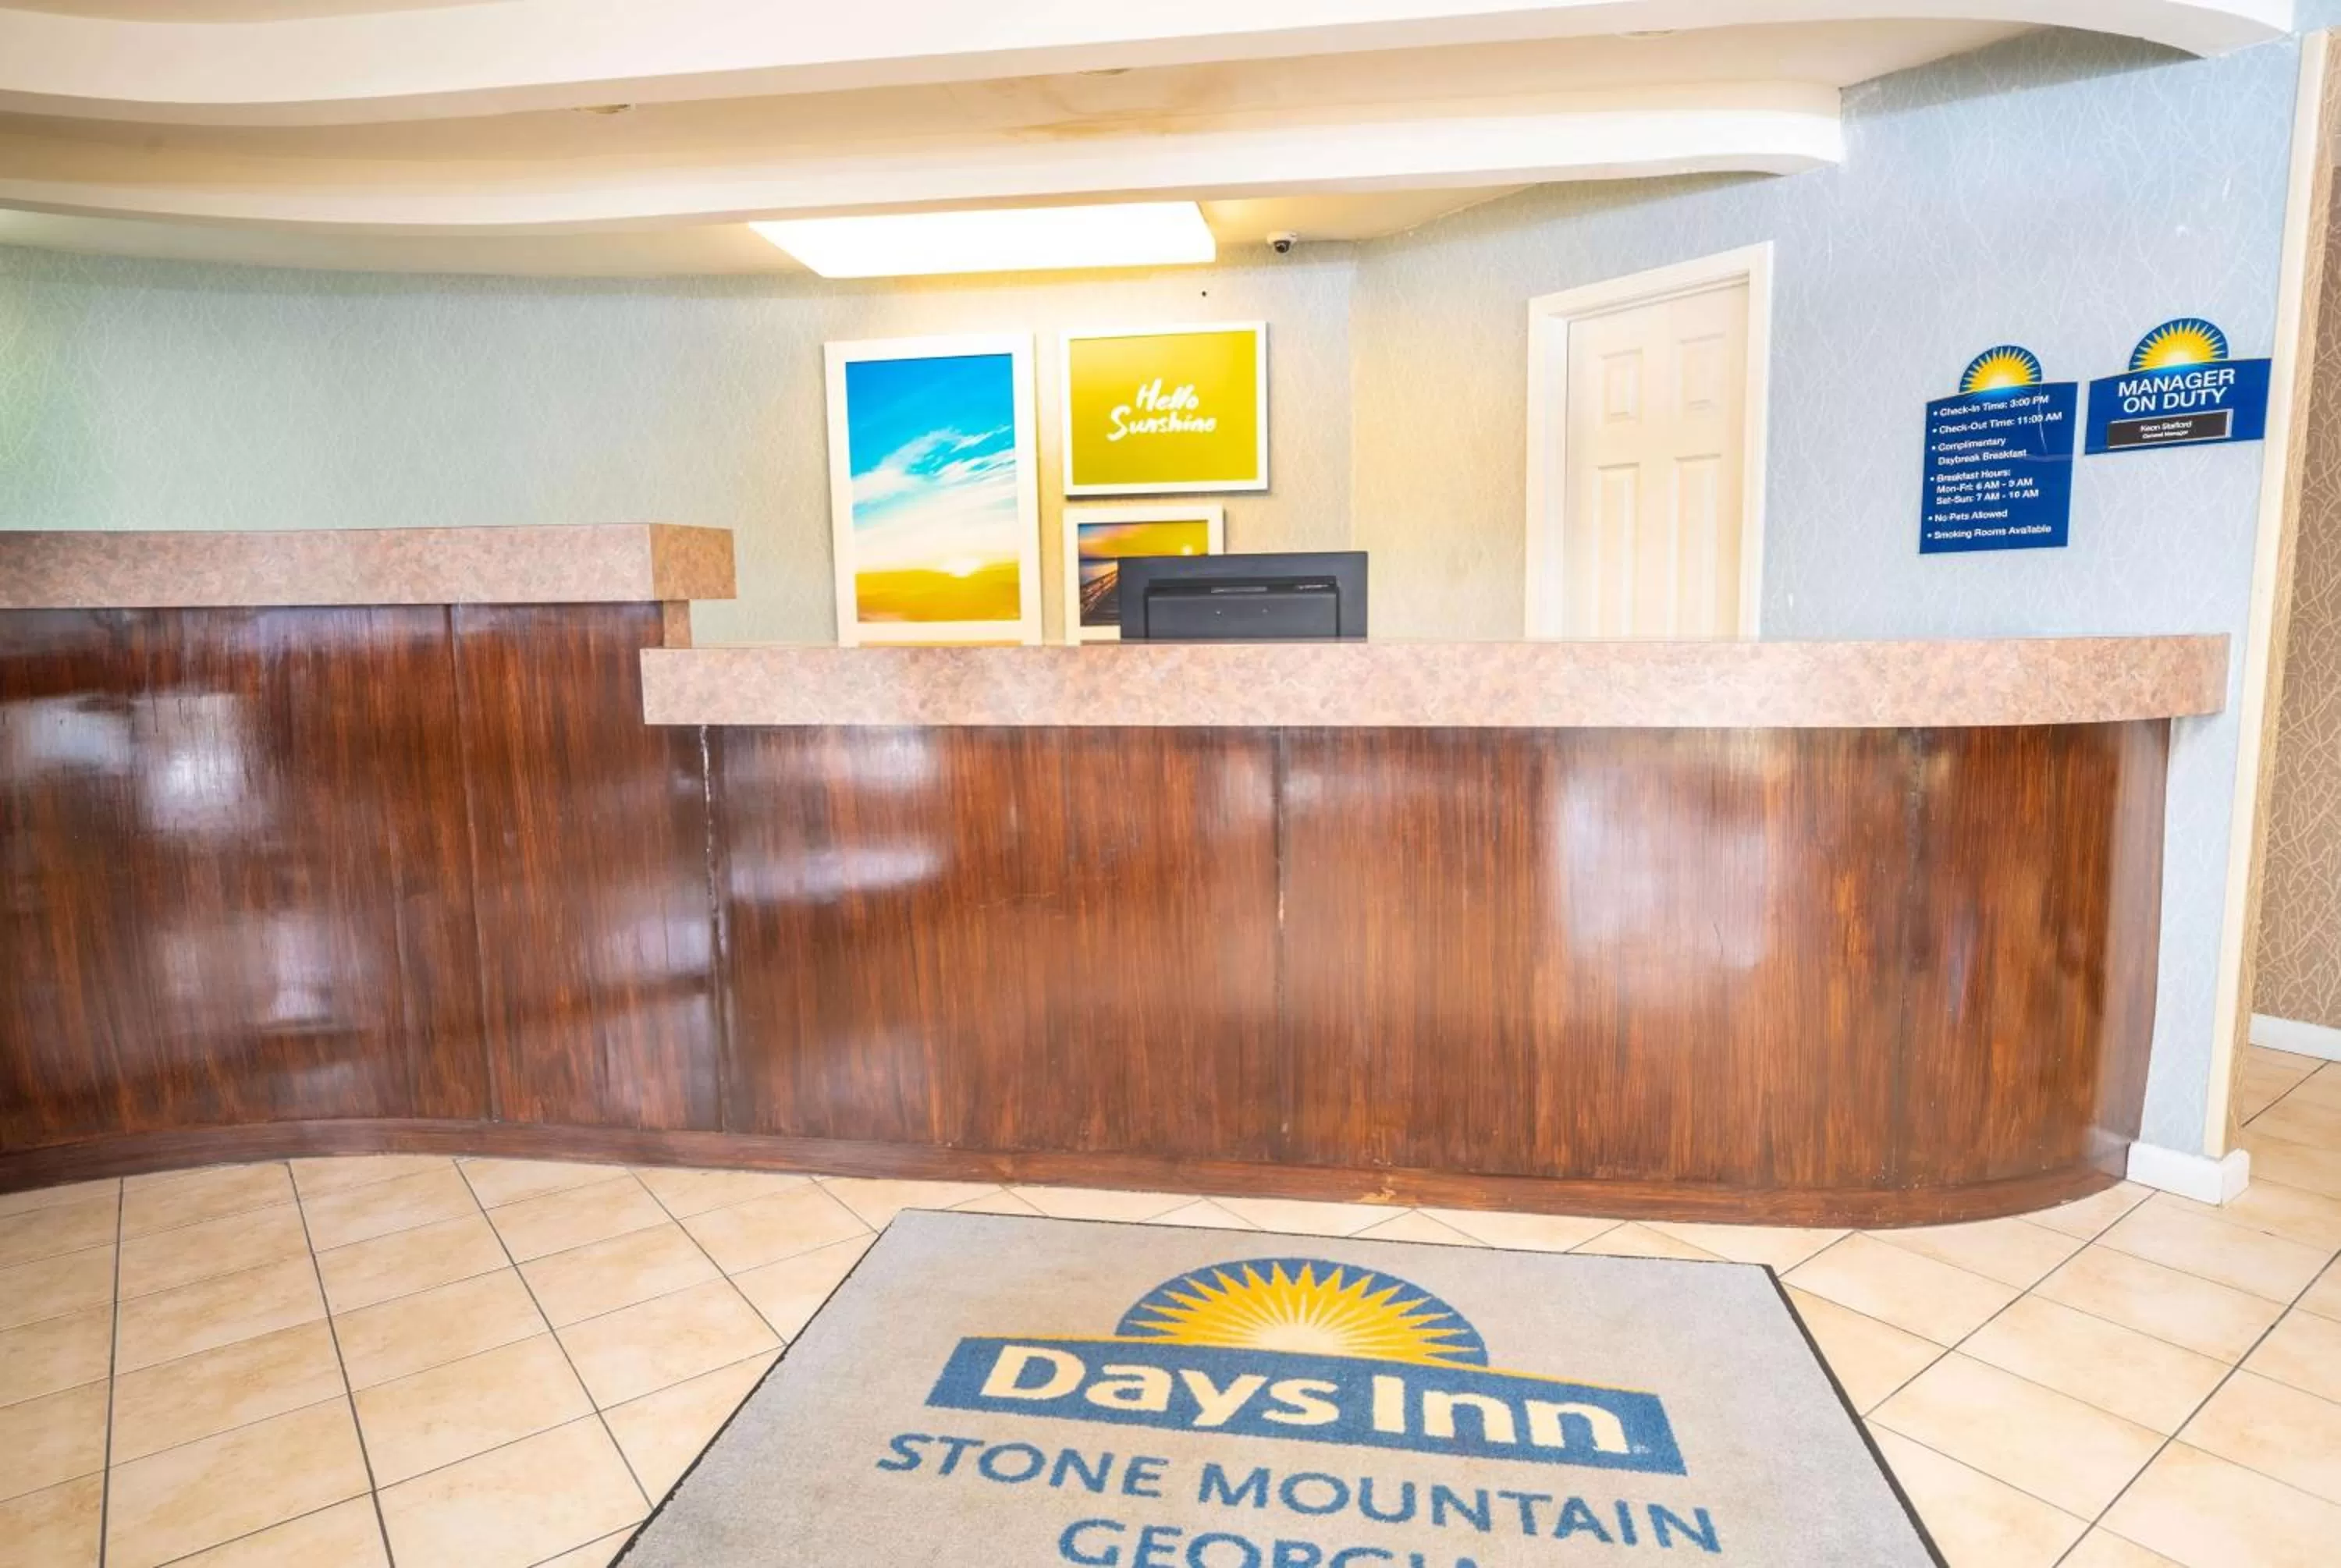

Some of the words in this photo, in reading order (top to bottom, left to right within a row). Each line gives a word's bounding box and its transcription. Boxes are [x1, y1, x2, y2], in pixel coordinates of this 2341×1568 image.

[2118, 368, 2235, 397] MANAGER
[1136, 378, 1199, 413] Hello
[1939, 405, 1980, 417] Check-In
[1984, 402, 2008, 411] Time:
[2010, 399, 2029, 408] 3:00
[2032, 395, 2050, 405] PM
[2123, 396, 2156, 413] ON
[2162, 387, 2227, 410] DUTY
[1107, 406, 1217, 442] Sunshine
[1939, 421, 1988, 434] Check-Out
[1990, 419, 2016, 428] Time:
[2017, 415, 2043, 425] 11:00
[2045, 412, 2062, 422] AM
[1938, 438, 2006, 452] Complimentary
[1938, 453, 1980, 466] Daybreak
[1983, 449, 2027, 460] Breakfast
[1936, 484, 1973, 494] Mon-Fri:
[1983, 481, 1999, 489] AM
[2016, 477, 2033, 487] AM
[1937, 472, 1980, 482] Breakfast
[1980, 469, 2011, 479] Hours:
[1983, 491, 1999, 501] AM
[2022, 489, 2039, 498] AM
[1934, 513, 1947, 522] No
[1949, 512, 1969, 521] Pets
[1971, 509, 2008, 520] Allowed
[1934, 529, 1972, 539] Smoking
[1974, 527, 2006, 537] Rooms
[2008, 524, 2051, 535] Available
[979, 1345, 1340, 1427] Days
[1372, 1375, 1629, 1454] Inn
[876, 1432, 1170, 1499] STONE
[1198, 1462, 1722, 1553] MOUNTAIN
[1057, 1518, 1480, 1568] GEOR
